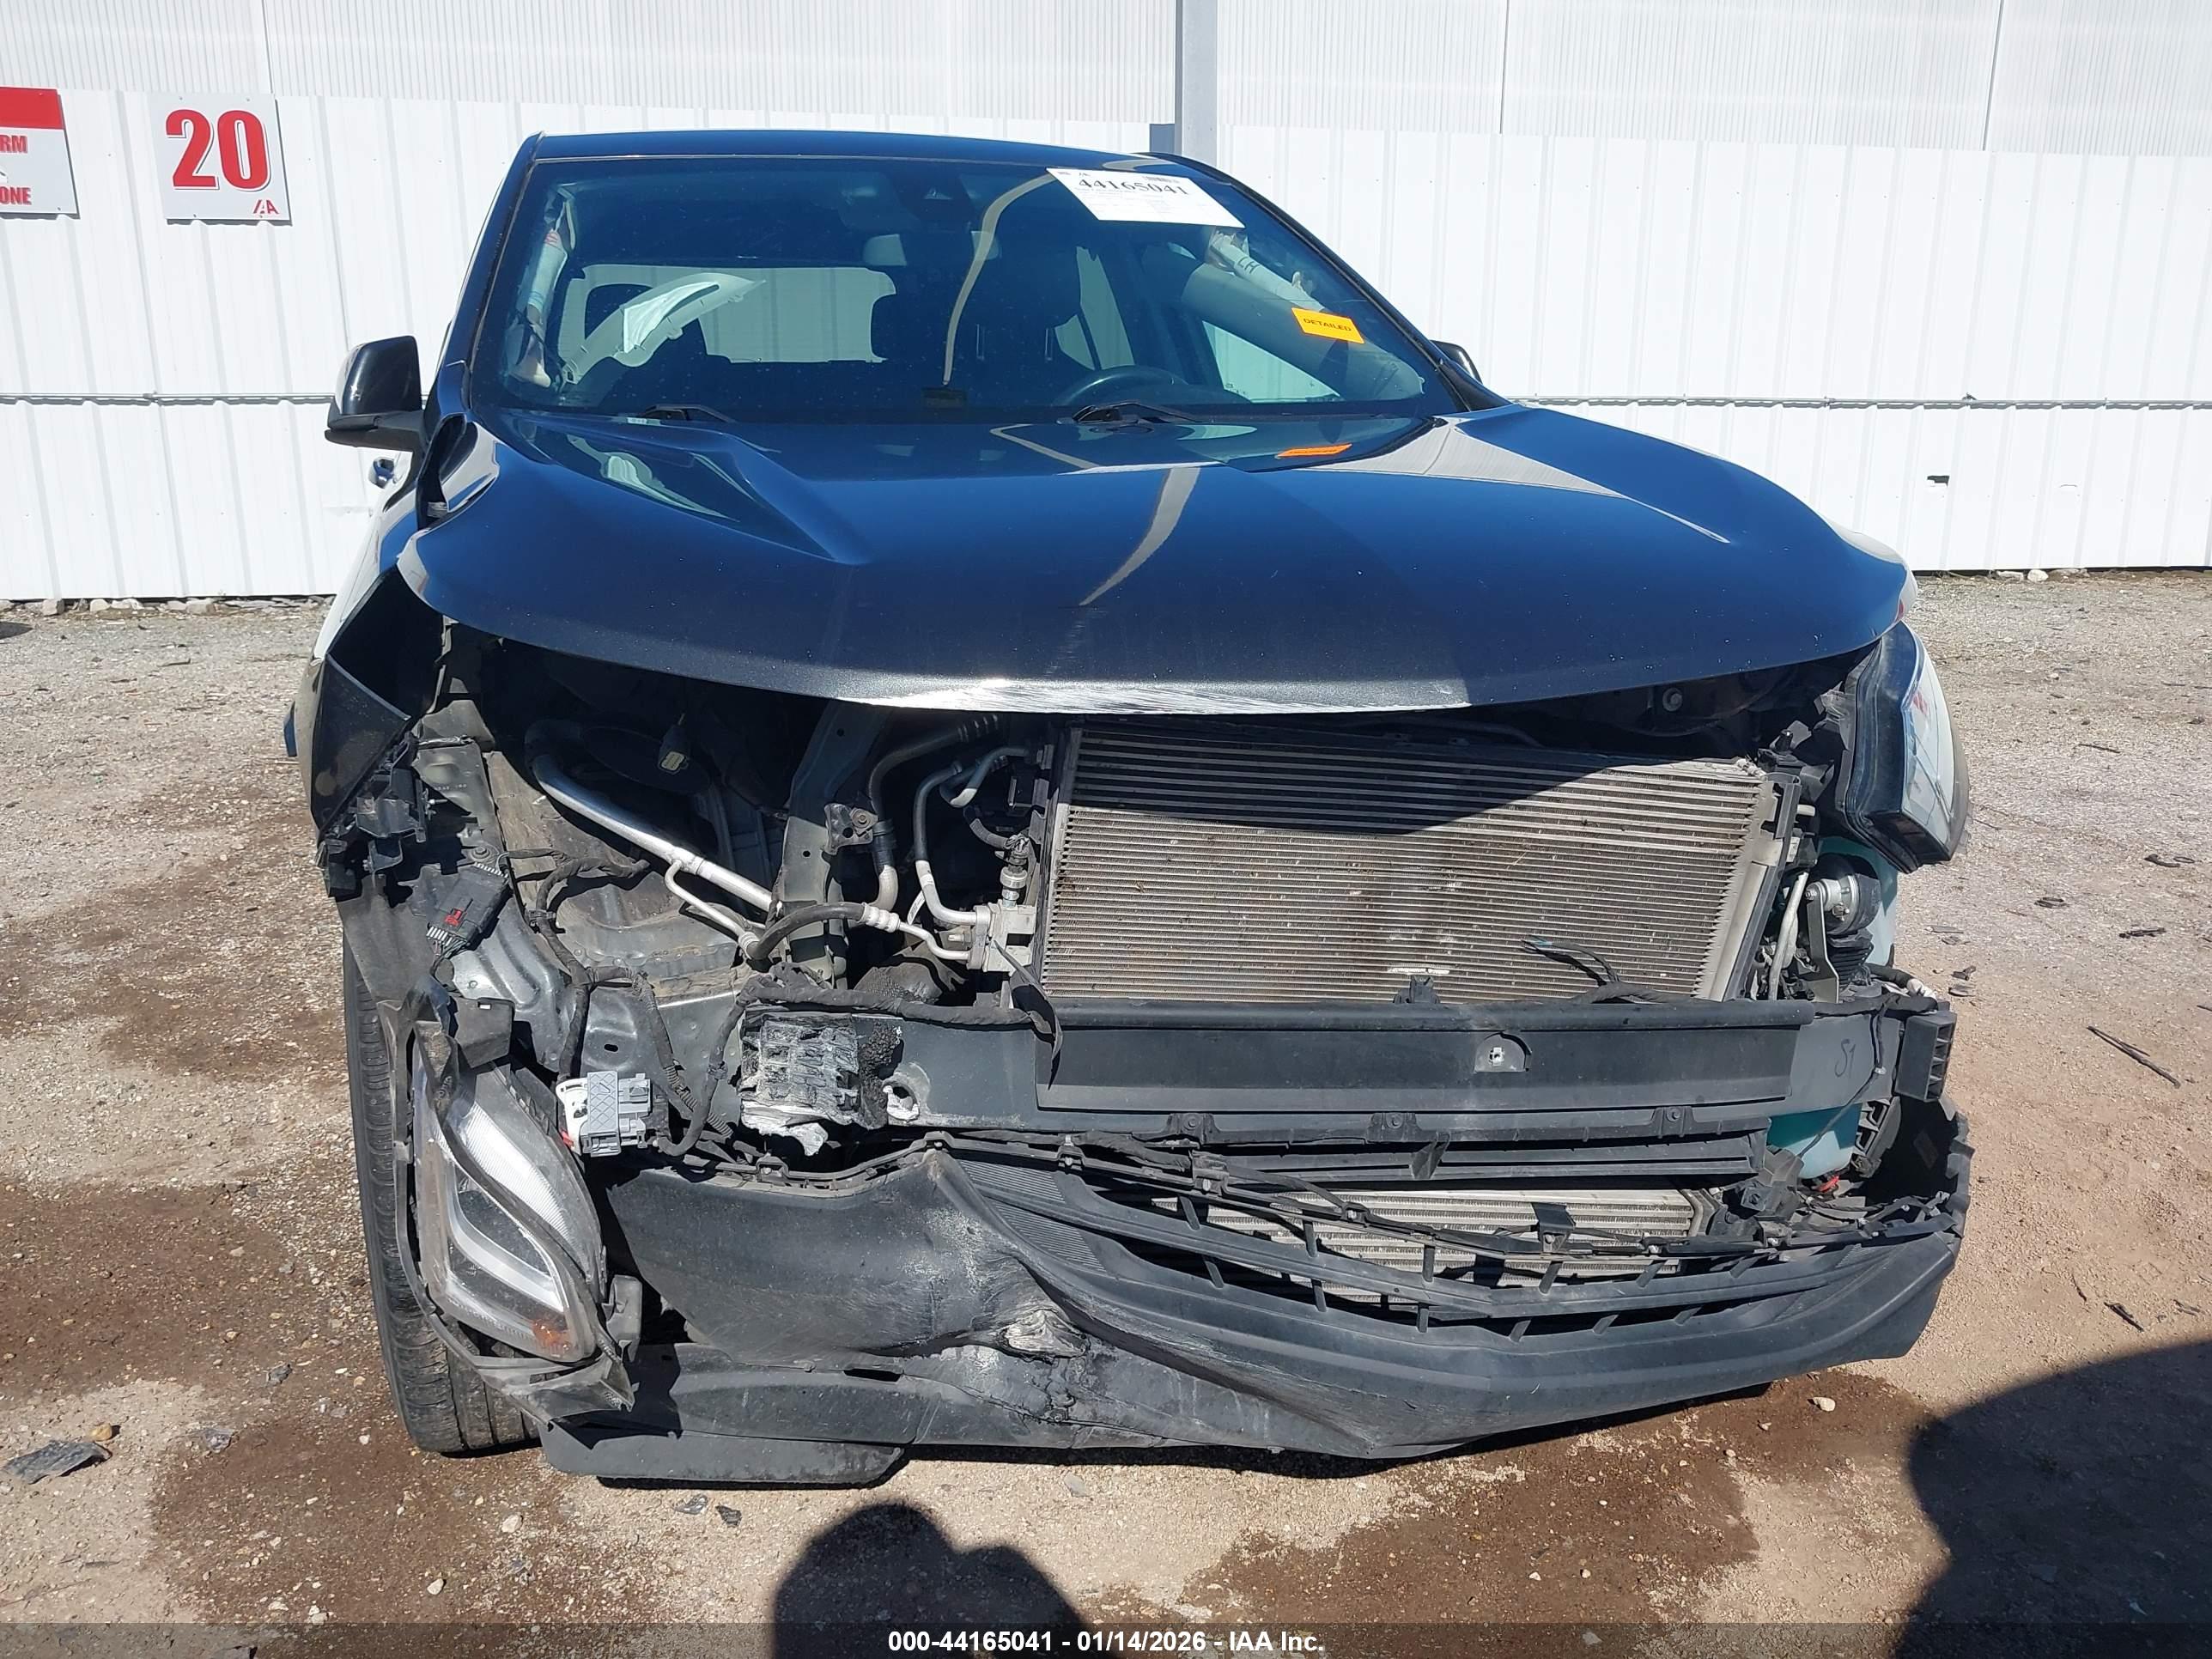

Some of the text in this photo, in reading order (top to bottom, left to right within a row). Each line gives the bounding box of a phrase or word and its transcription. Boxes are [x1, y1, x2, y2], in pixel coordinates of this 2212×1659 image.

[165, 109, 270, 191] 20
[1079, 179, 1188, 195] 44165041
[1303, 318, 1352, 331] DETAILED
